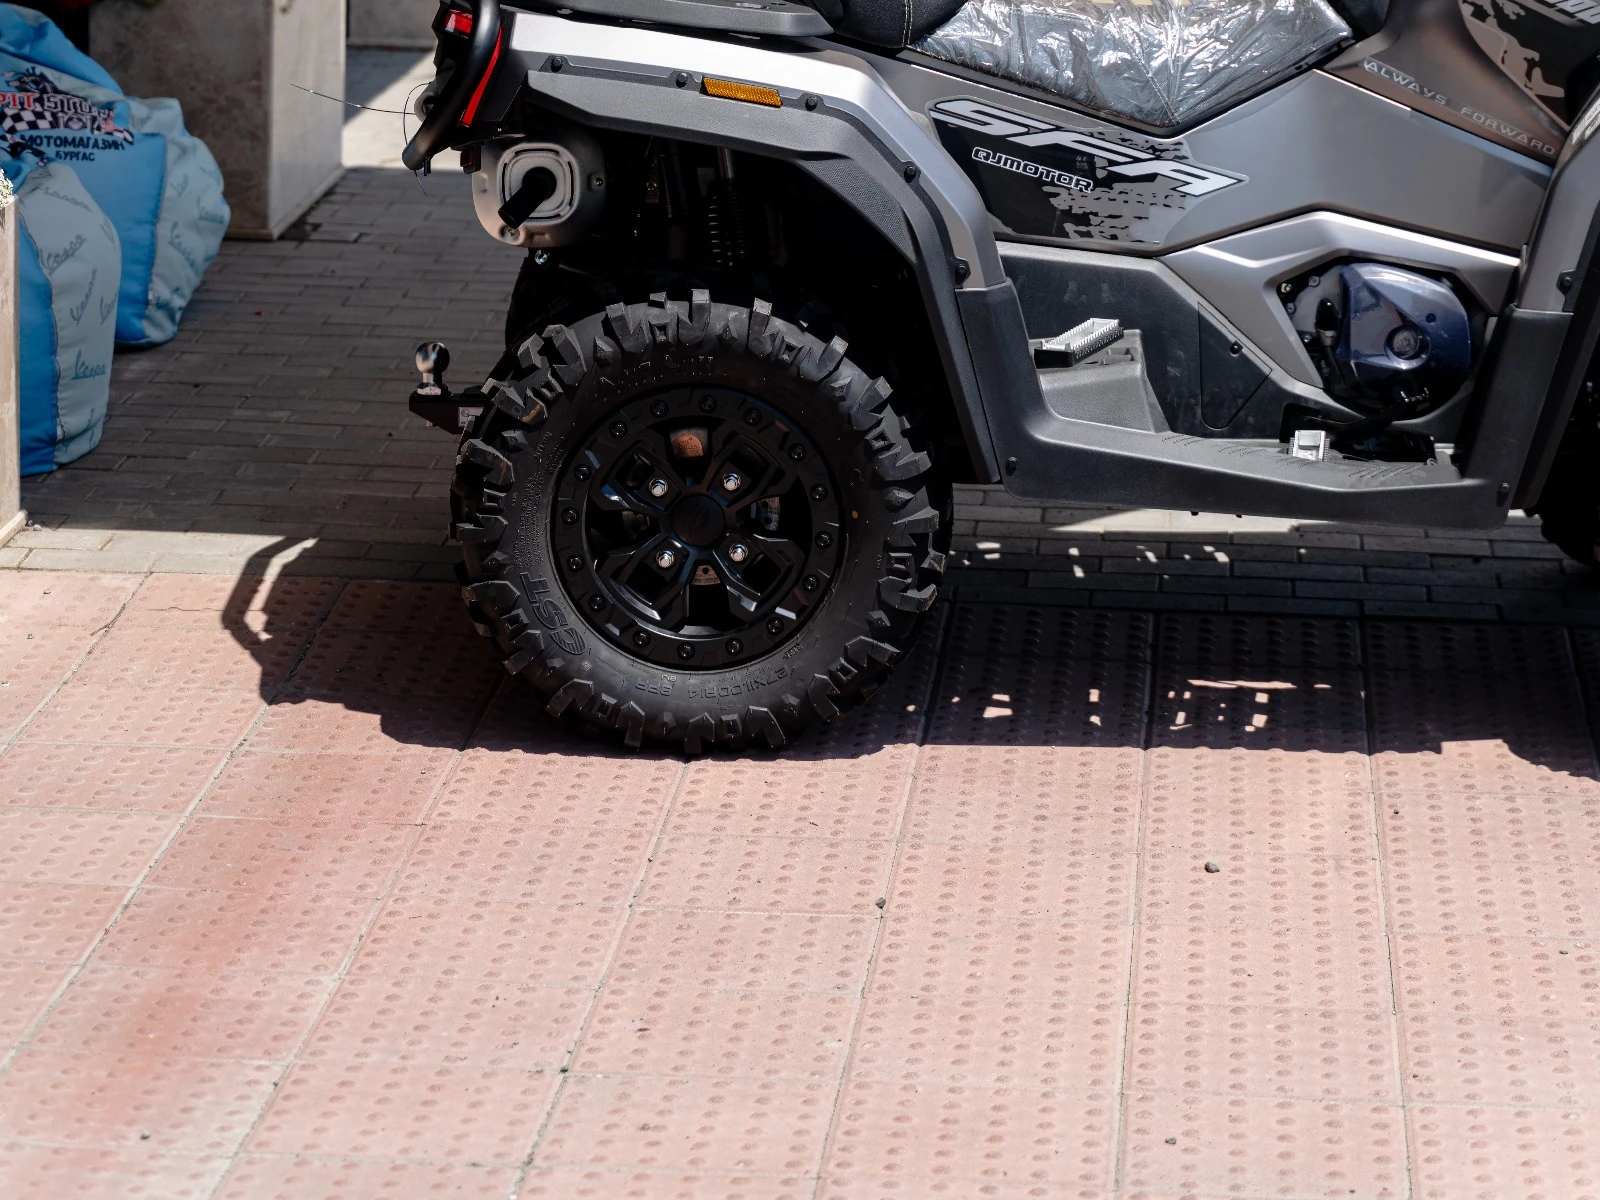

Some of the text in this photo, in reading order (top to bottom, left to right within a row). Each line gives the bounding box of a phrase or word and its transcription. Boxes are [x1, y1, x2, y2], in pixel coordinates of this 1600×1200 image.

[1363, 57, 1448, 107] ALWAYS
[1460, 106, 1556, 156] FORWARD
[21, 135, 125, 151] МОТОМАГАЗИН
[56, 151, 95, 161] БУРГАС
[971, 146, 1094, 193] QJMOTOR
[70, 267, 97, 327] Vespa
[71, 350, 106, 380] Vespa
[519, 571, 587, 656] CST
